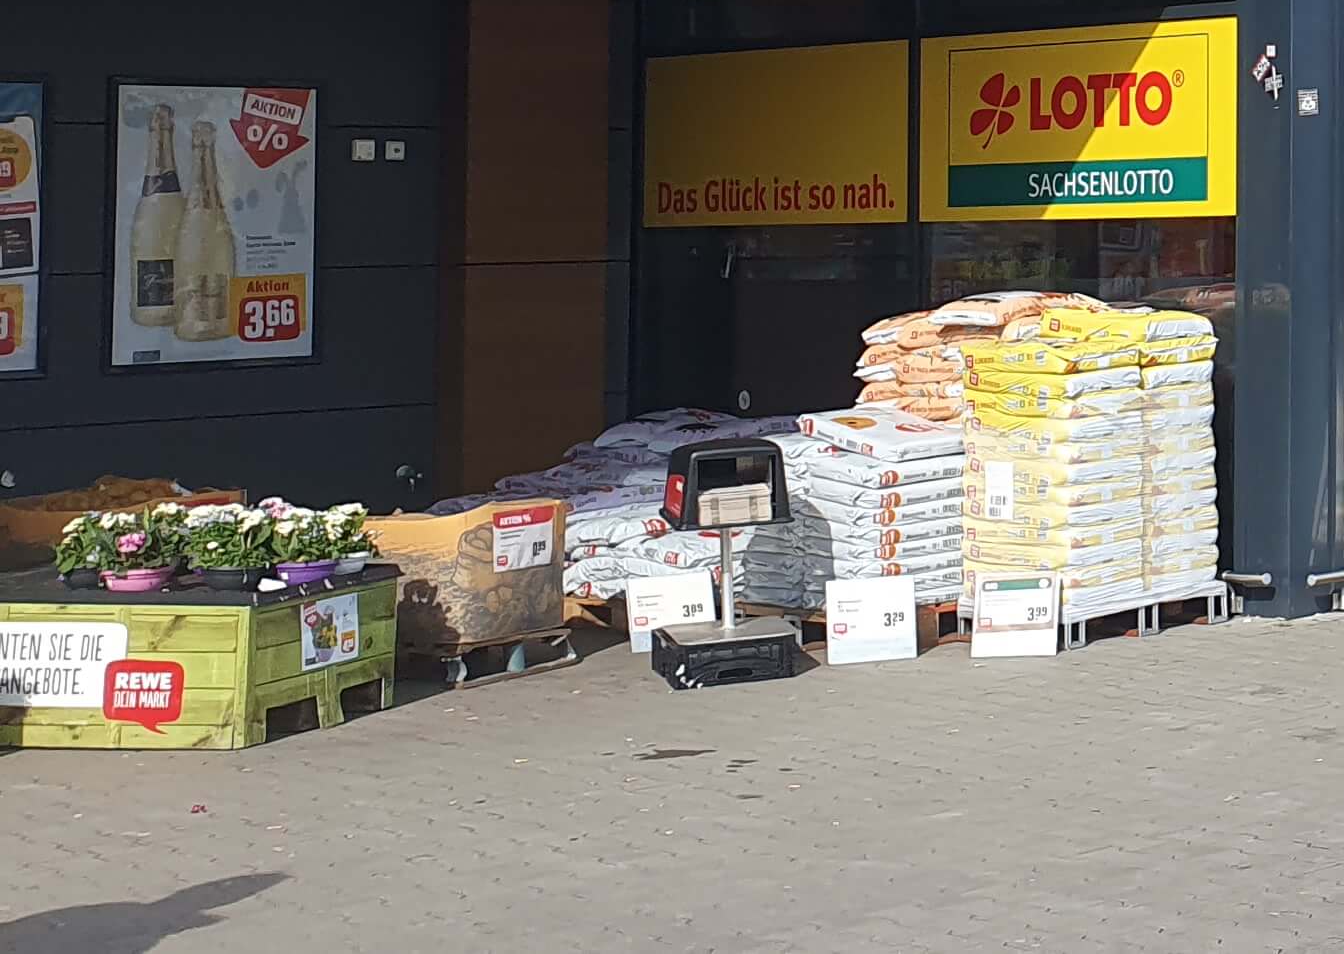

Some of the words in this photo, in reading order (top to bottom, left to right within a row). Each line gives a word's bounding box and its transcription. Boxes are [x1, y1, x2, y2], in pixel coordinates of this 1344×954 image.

[250, 99, 297, 121] AKTION
[657, 181, 698, 215] Das
[704, 176, 767, 213] Glück
[771, 175, 801, 211] ist
[807, 184, 836, 211] so
[842, 174, 895, 211] nah.
[1028, 169, 1174, 199] SACHSENLOTTO
[246, 278, 290, 294] Aktion
[244, 298, 296, 339] 3.66
[1027, 606, 1048, 622] 3.99
[49, 633, 76, 662] SIE
[81, 633, 104, 662] DIE
[0, 666, 85, 697] ANGEBOTE.
[114, 672, 174, 691] REWE
[113, 691, 136, 709] DEIN
[138, 689, 171, 709] MARKT
